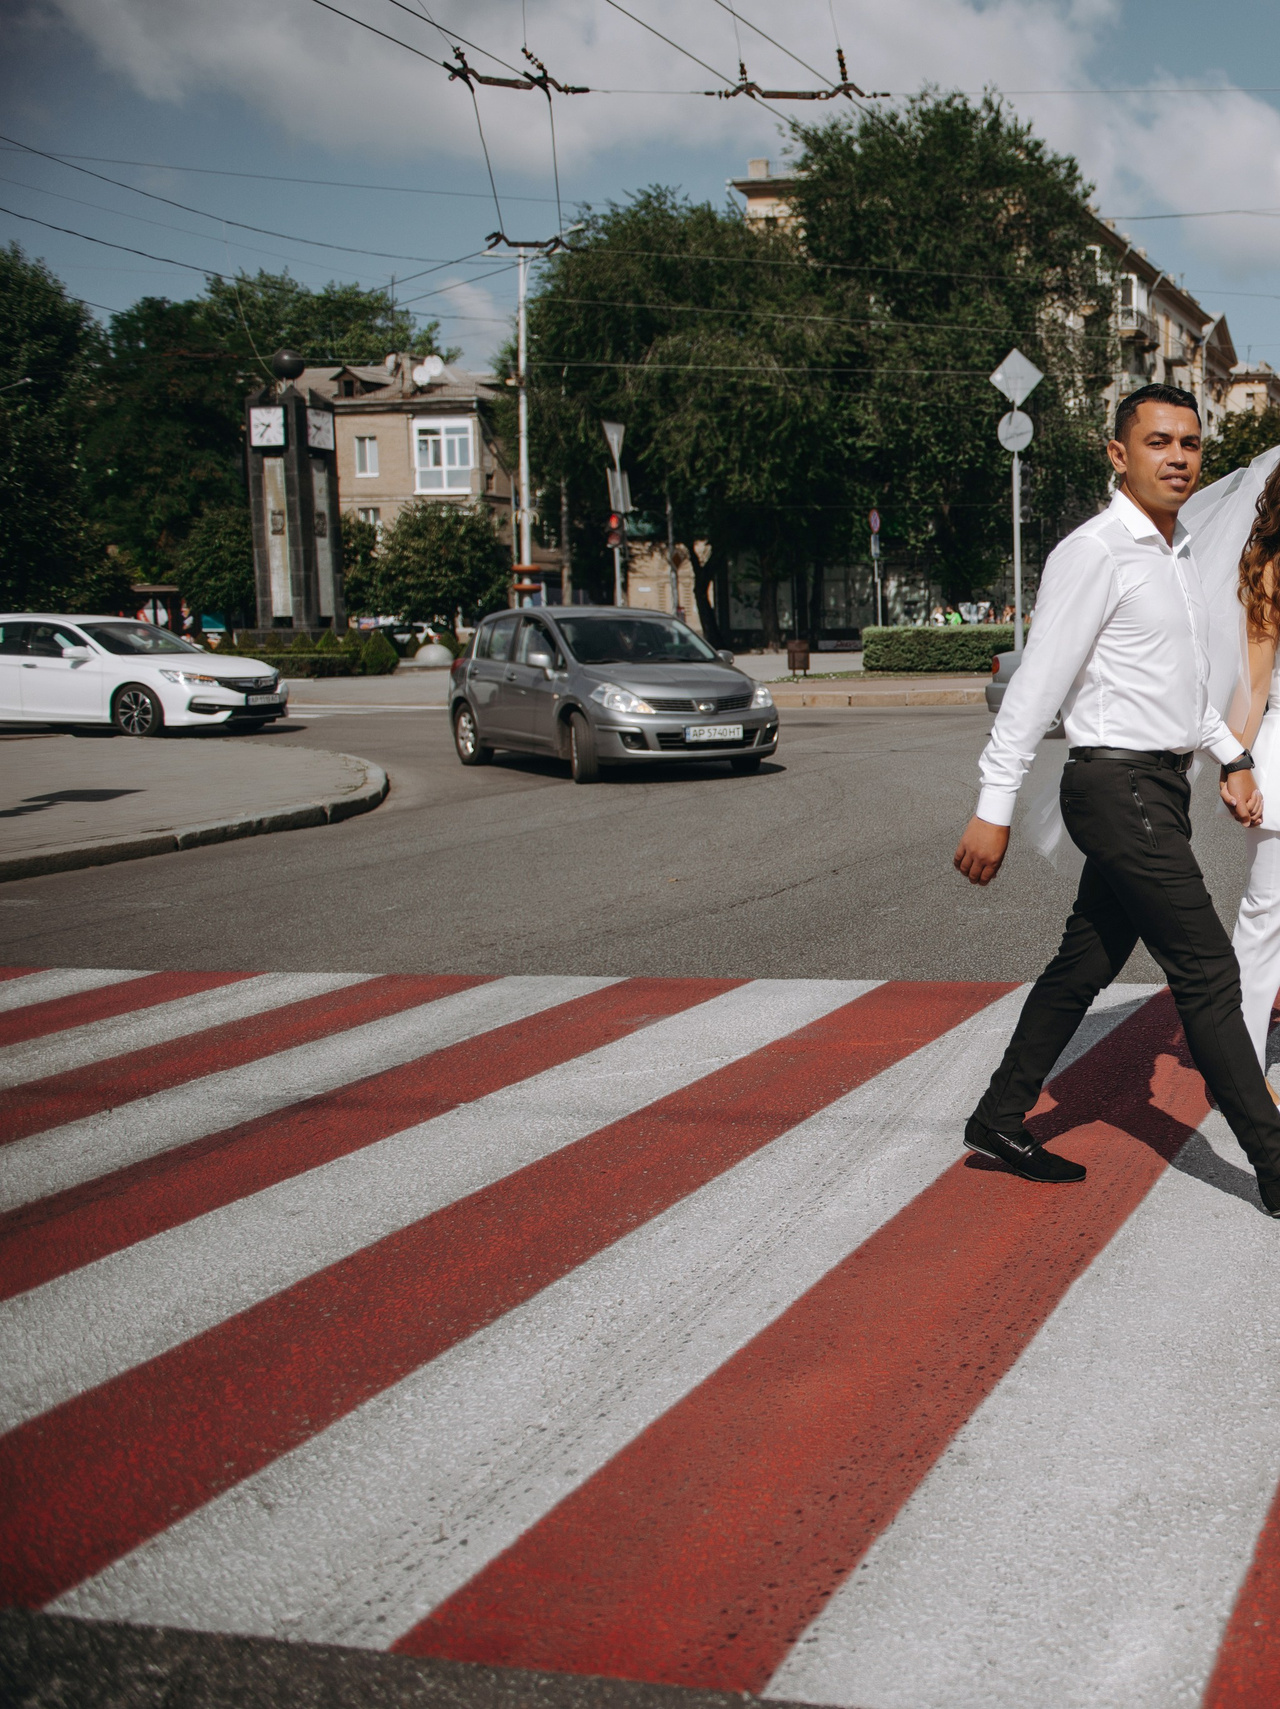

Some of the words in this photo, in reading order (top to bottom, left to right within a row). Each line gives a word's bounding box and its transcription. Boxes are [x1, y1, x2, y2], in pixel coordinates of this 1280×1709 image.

[692, 728, 705, 738] AP
[707, 728, 728, 738] 5740
[728, 727, 741, 737] HT
